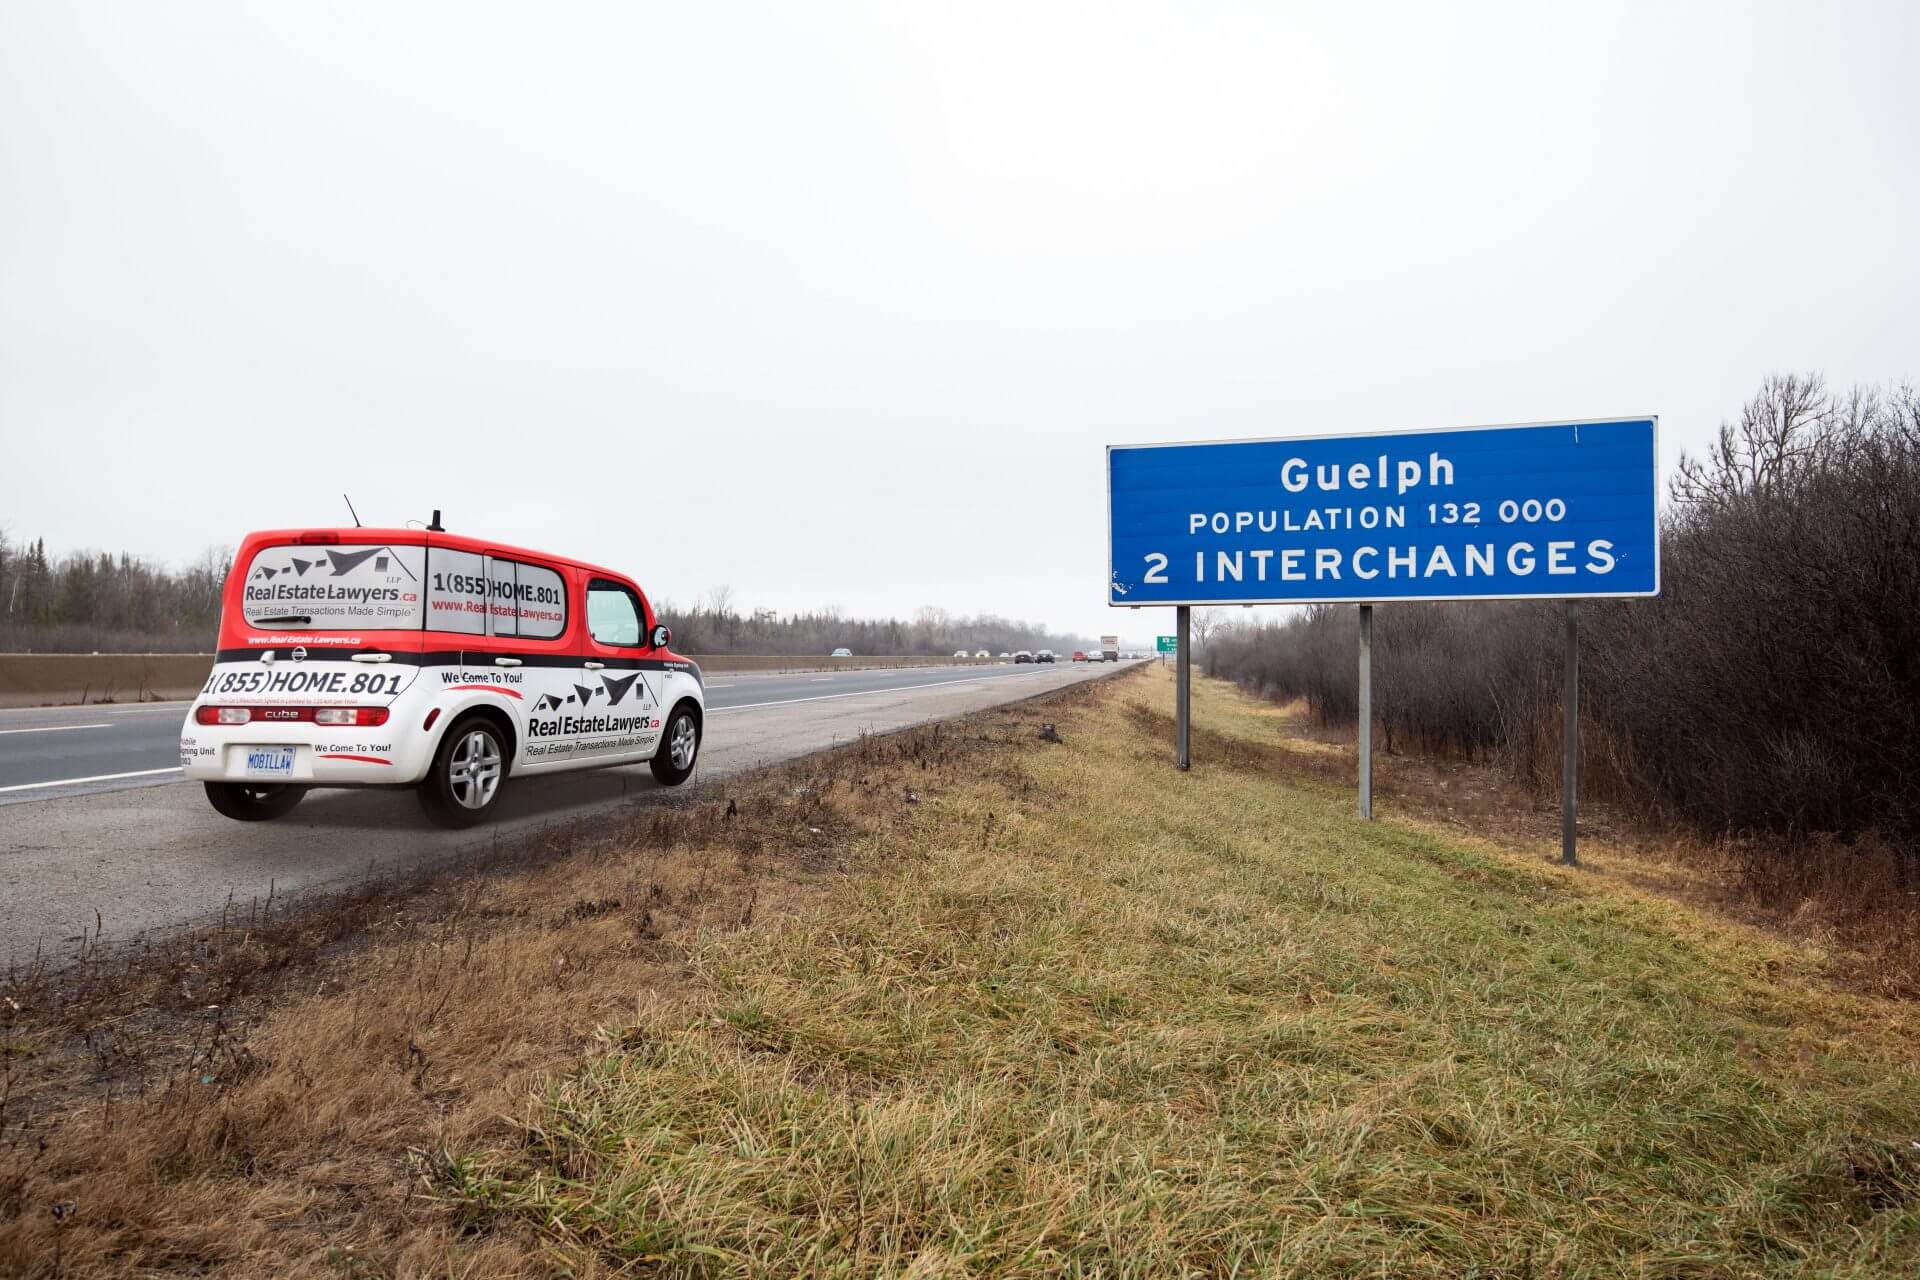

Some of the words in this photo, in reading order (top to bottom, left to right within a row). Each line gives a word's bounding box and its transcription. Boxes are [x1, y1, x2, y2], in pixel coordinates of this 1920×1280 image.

[1281, 451, 1455, 494] Guelph
[1190, 505, 1406, 535] POPULATION
[1428, 502, 1482, 524] 132
[1499, 498, 1567, 524] 000
[1143, 552, 1169, 584] 2
[1196, 538, 1617, 583] INTERCHANGES
[292, 606, 346, 616] Transactions
[348, 605, 374, 616] Made
[441, 672, 460, 684] We
[462, 672, 489, 684] Come
[490, 672, 502, 684] To
[504, 672, 523, 684] You!
[264, 710, 299, 719] cube
[200, 747, 216, 756] Unit
[314, 744, 328, 752] We
[329, 744, 354, 752] Come
[356, 744, 367, 752] To
[370, 743, 392, 752] You!
[547, 742, 573, 755] Estate
[574, 738, 616, 752] Transactions
[247, 753, 292, 770] MOBILLAW
